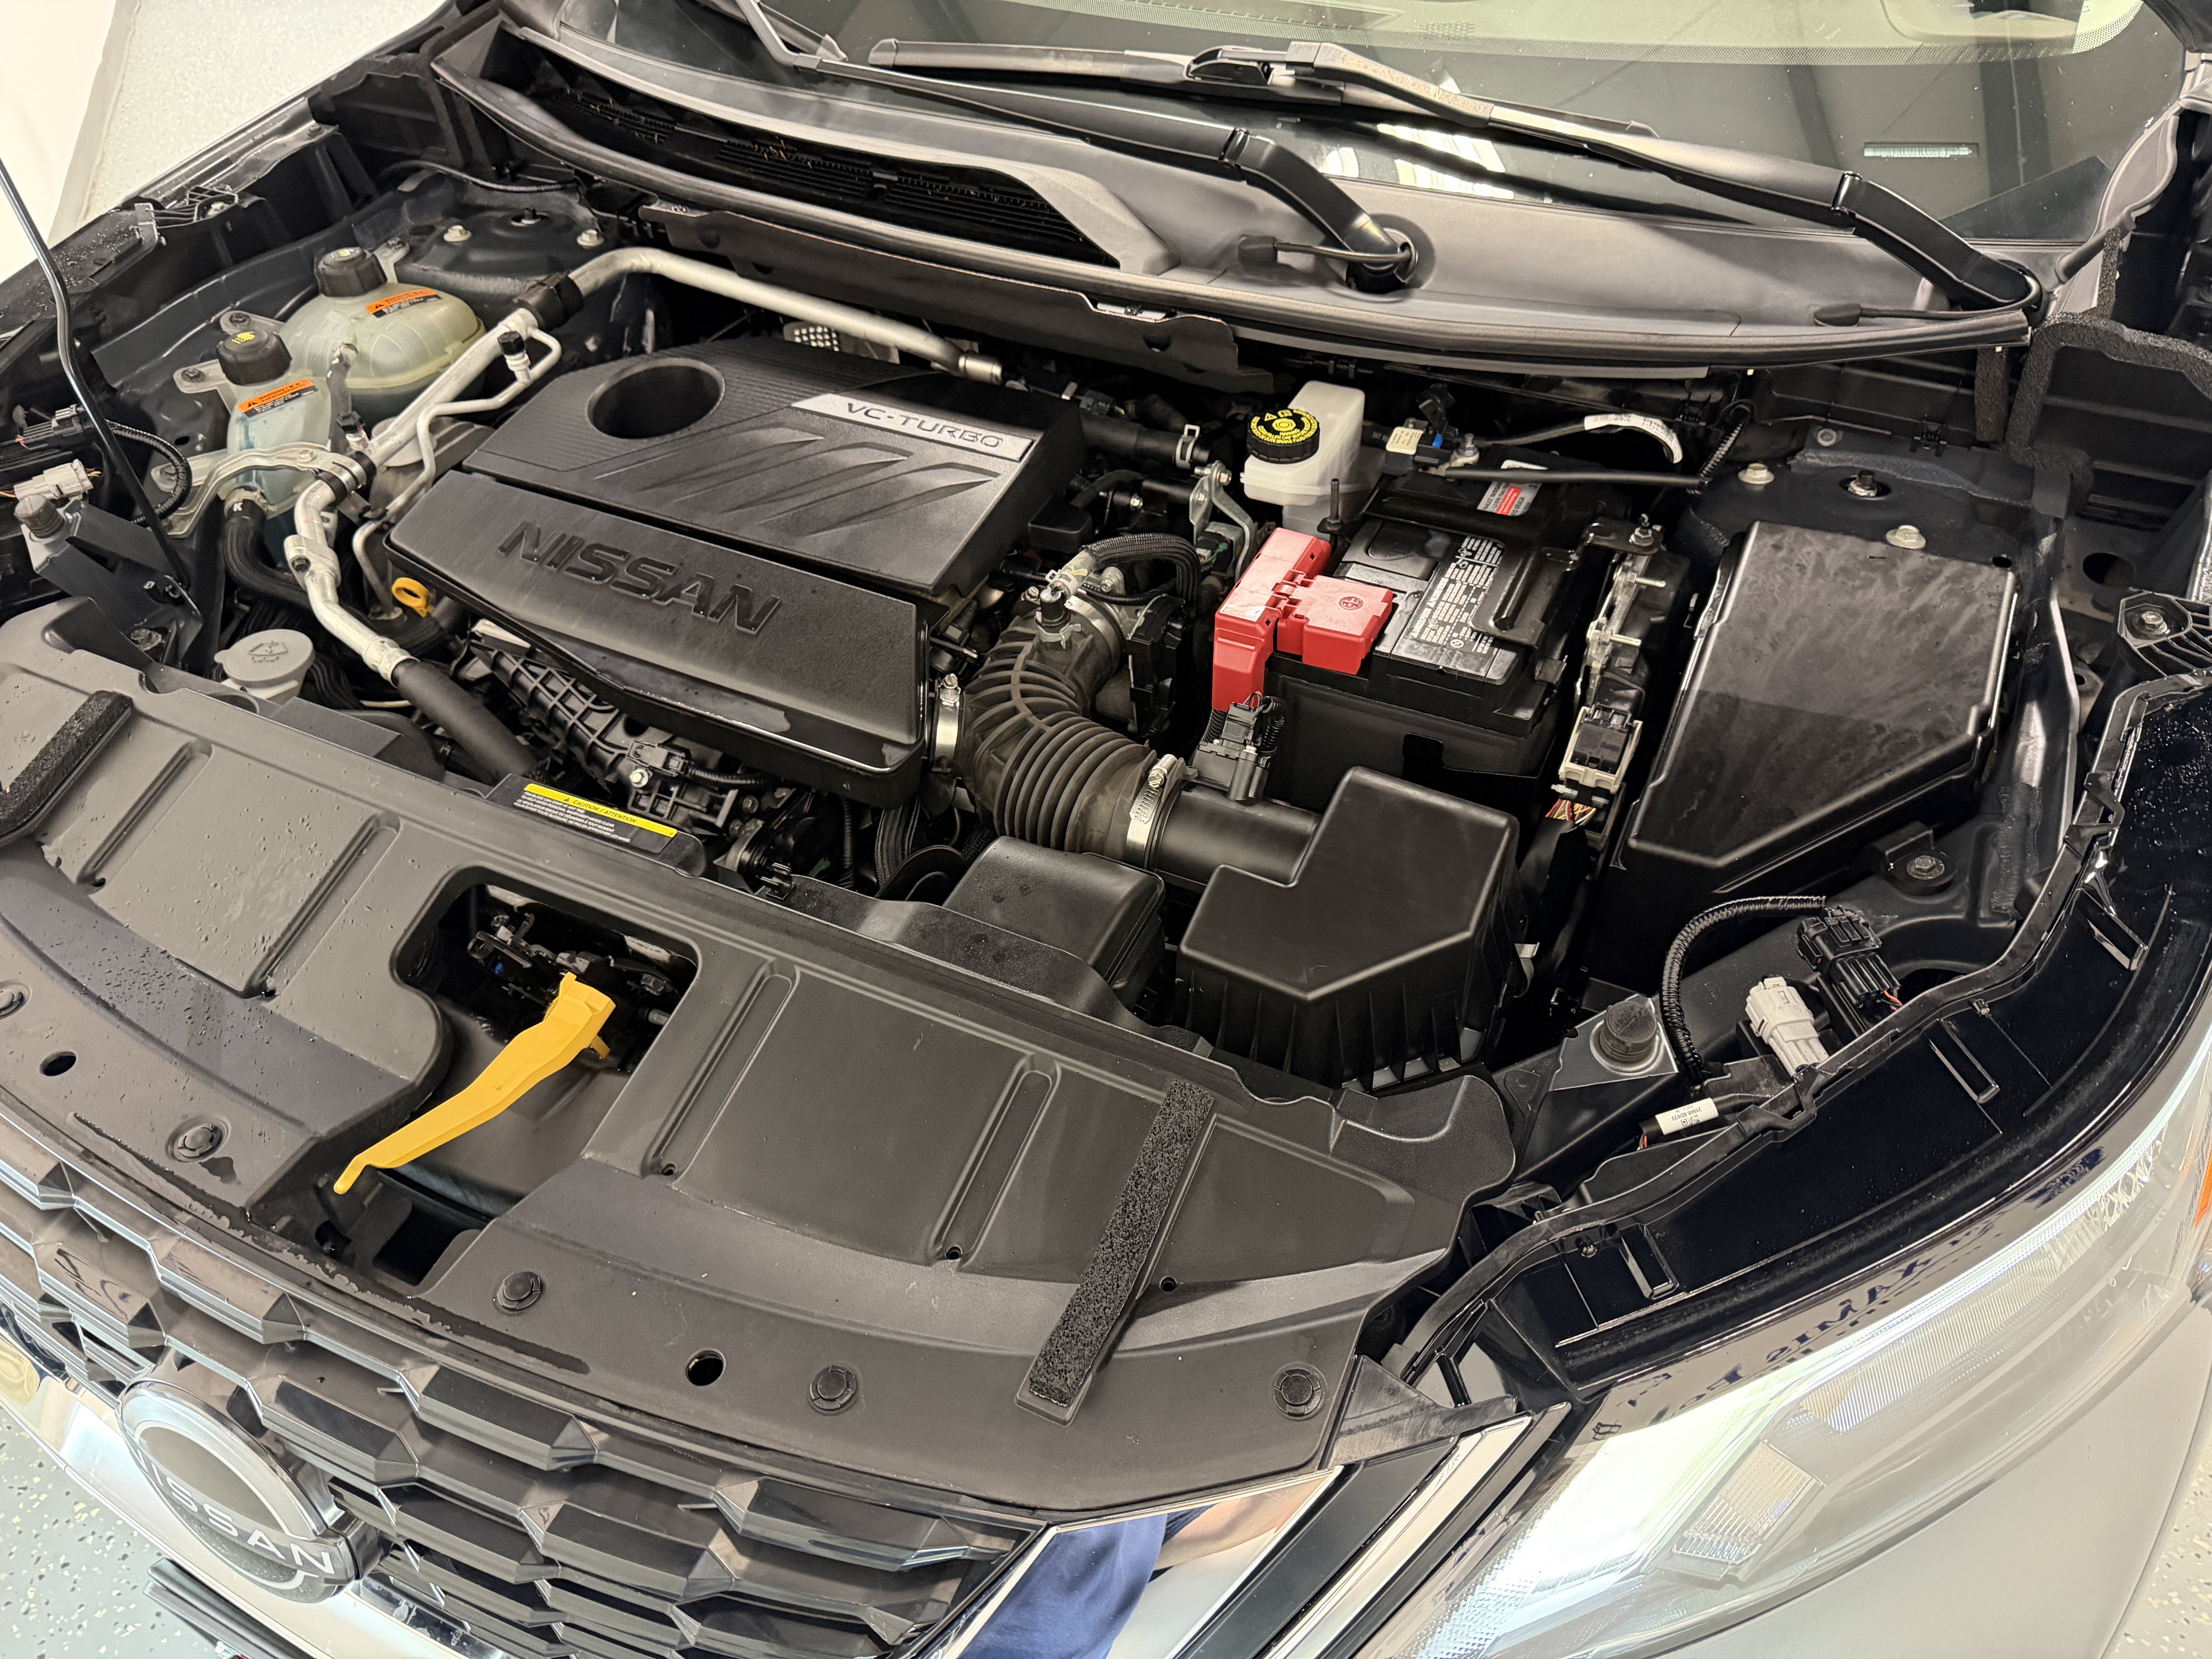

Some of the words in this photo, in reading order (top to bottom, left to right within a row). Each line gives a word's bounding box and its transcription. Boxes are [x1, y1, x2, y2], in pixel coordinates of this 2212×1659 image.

[846, 402, 1003, 448] VC-TURBO
[497, 521, 782, 635] NISSAN
[572, 800, 599, 811] CAUTION
[603, 810, 637, 823] ATTENTION
[134, 1443, 336, 1575] NISSAN
